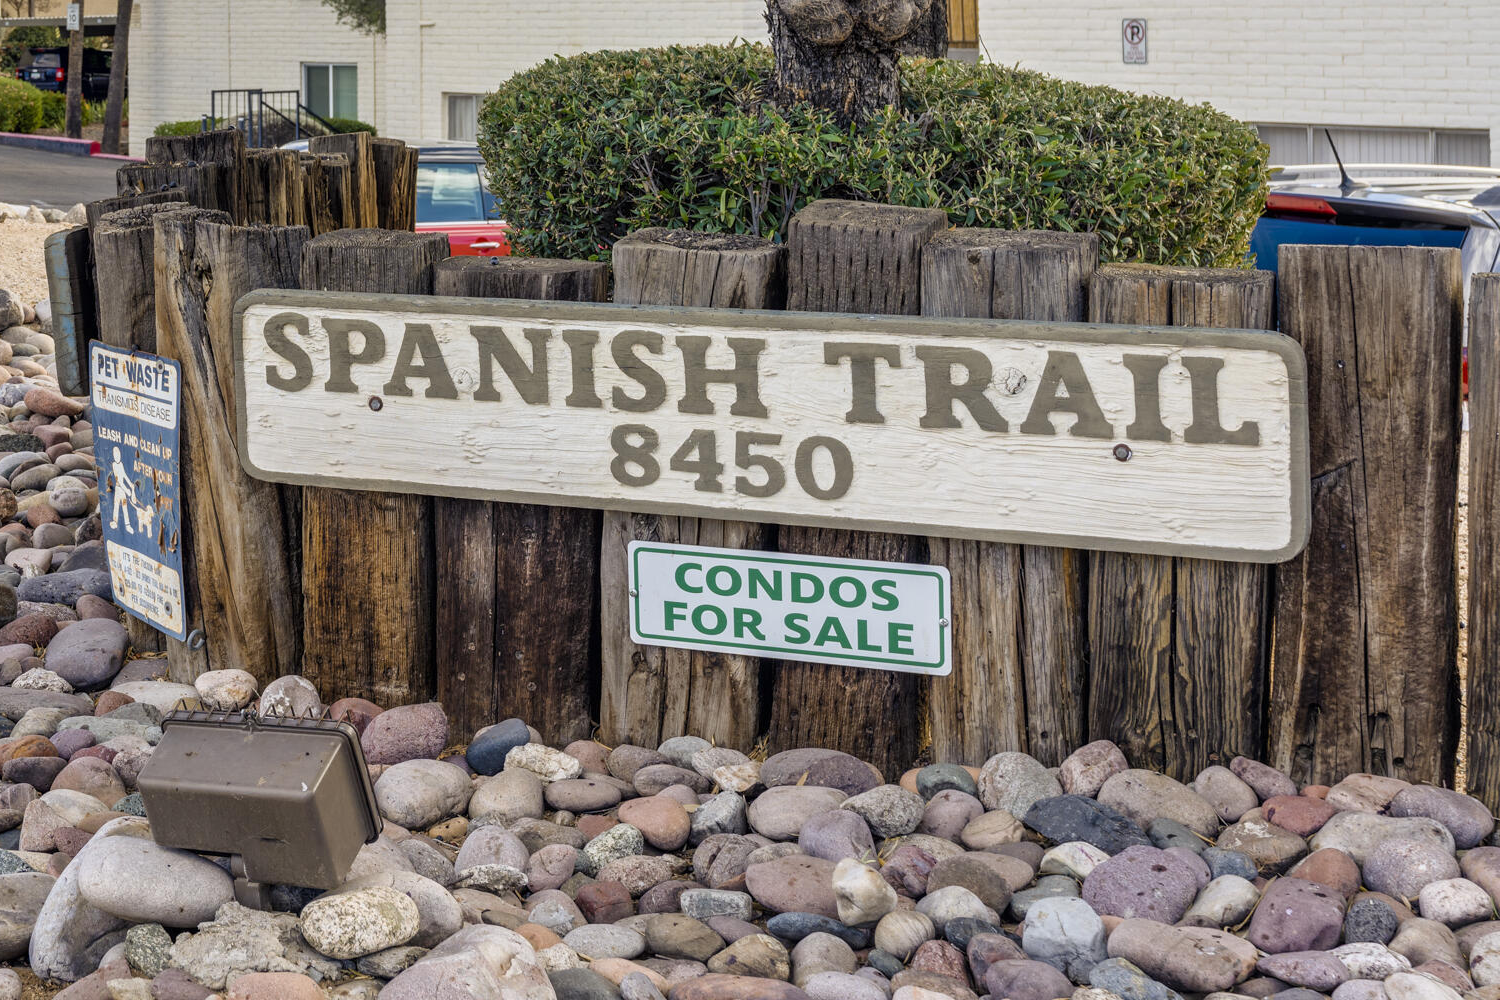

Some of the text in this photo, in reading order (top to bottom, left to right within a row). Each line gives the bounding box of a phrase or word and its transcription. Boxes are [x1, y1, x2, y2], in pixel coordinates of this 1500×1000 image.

[98, 353, 170, 393] PET WASTE
[263, 312, 1259, 445] SPANISH TRAIL
[97, 390, 171, 422] TRANSMITS DISEASE
[98, 425, 173, 460] LEASH AND CLEAN UP
[610, 423, 854, 500] 8450
[133, 460, 153, 477] AFTER
[674, 562, 900, 611] CONDOS
[664, 601, 915, 656] FOR SALE
